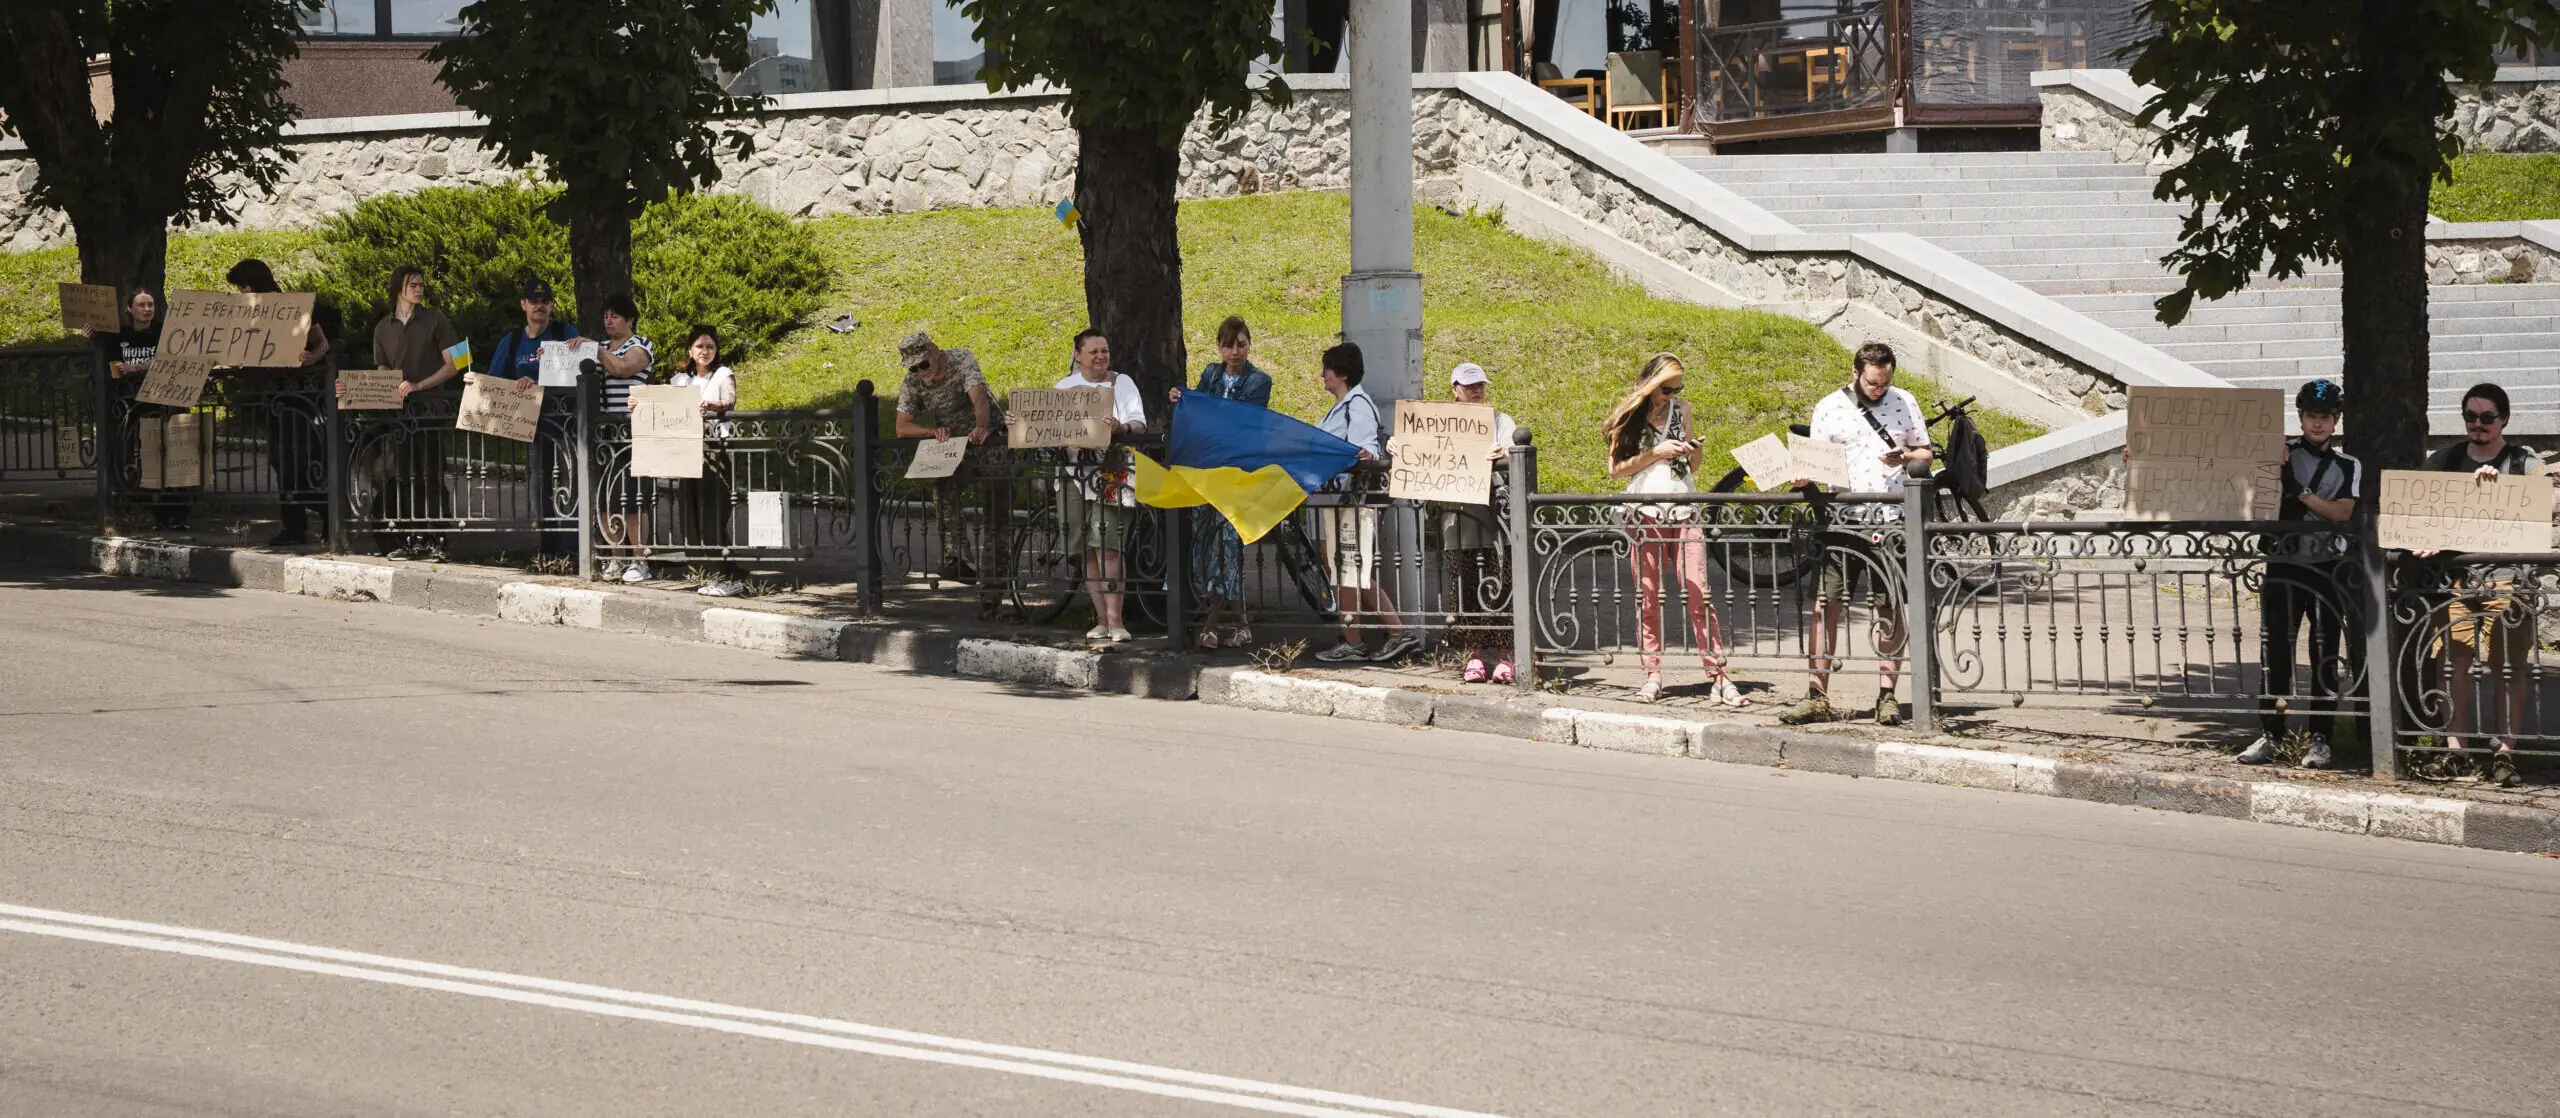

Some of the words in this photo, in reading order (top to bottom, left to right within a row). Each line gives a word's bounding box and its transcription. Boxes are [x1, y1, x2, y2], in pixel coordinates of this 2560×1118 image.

[168, 301, 196, 318] НЕ
[141, 382, 199, 403] ЦИФРАХ
[1021, 409, 1089, 422] ФЕДОРОВА
[1403, 411, 1488, 435] МАРІУПОЛЬ
[2128, 395, 2272, 430] ПОВЕРНІТЬ
[1025, 427, 1088, 446] СУМЩИНА
[1434, 435, 1455, 451] ТА
[2130, 431, 2266, 459] ФЕДОРОВА
[1401, 444, 1441, 470] СУМИ
[1446, 453, 1468, 471] ЗА
[2194, 455, 2214, 470] ТА
[1394, 468, 1488, 492] ФЕДОРОВА
[2387, 478, 2532, 508] ПОВЕРНІТЬ
[2386, 501, 2524, 534] ФЕДОРОВА
